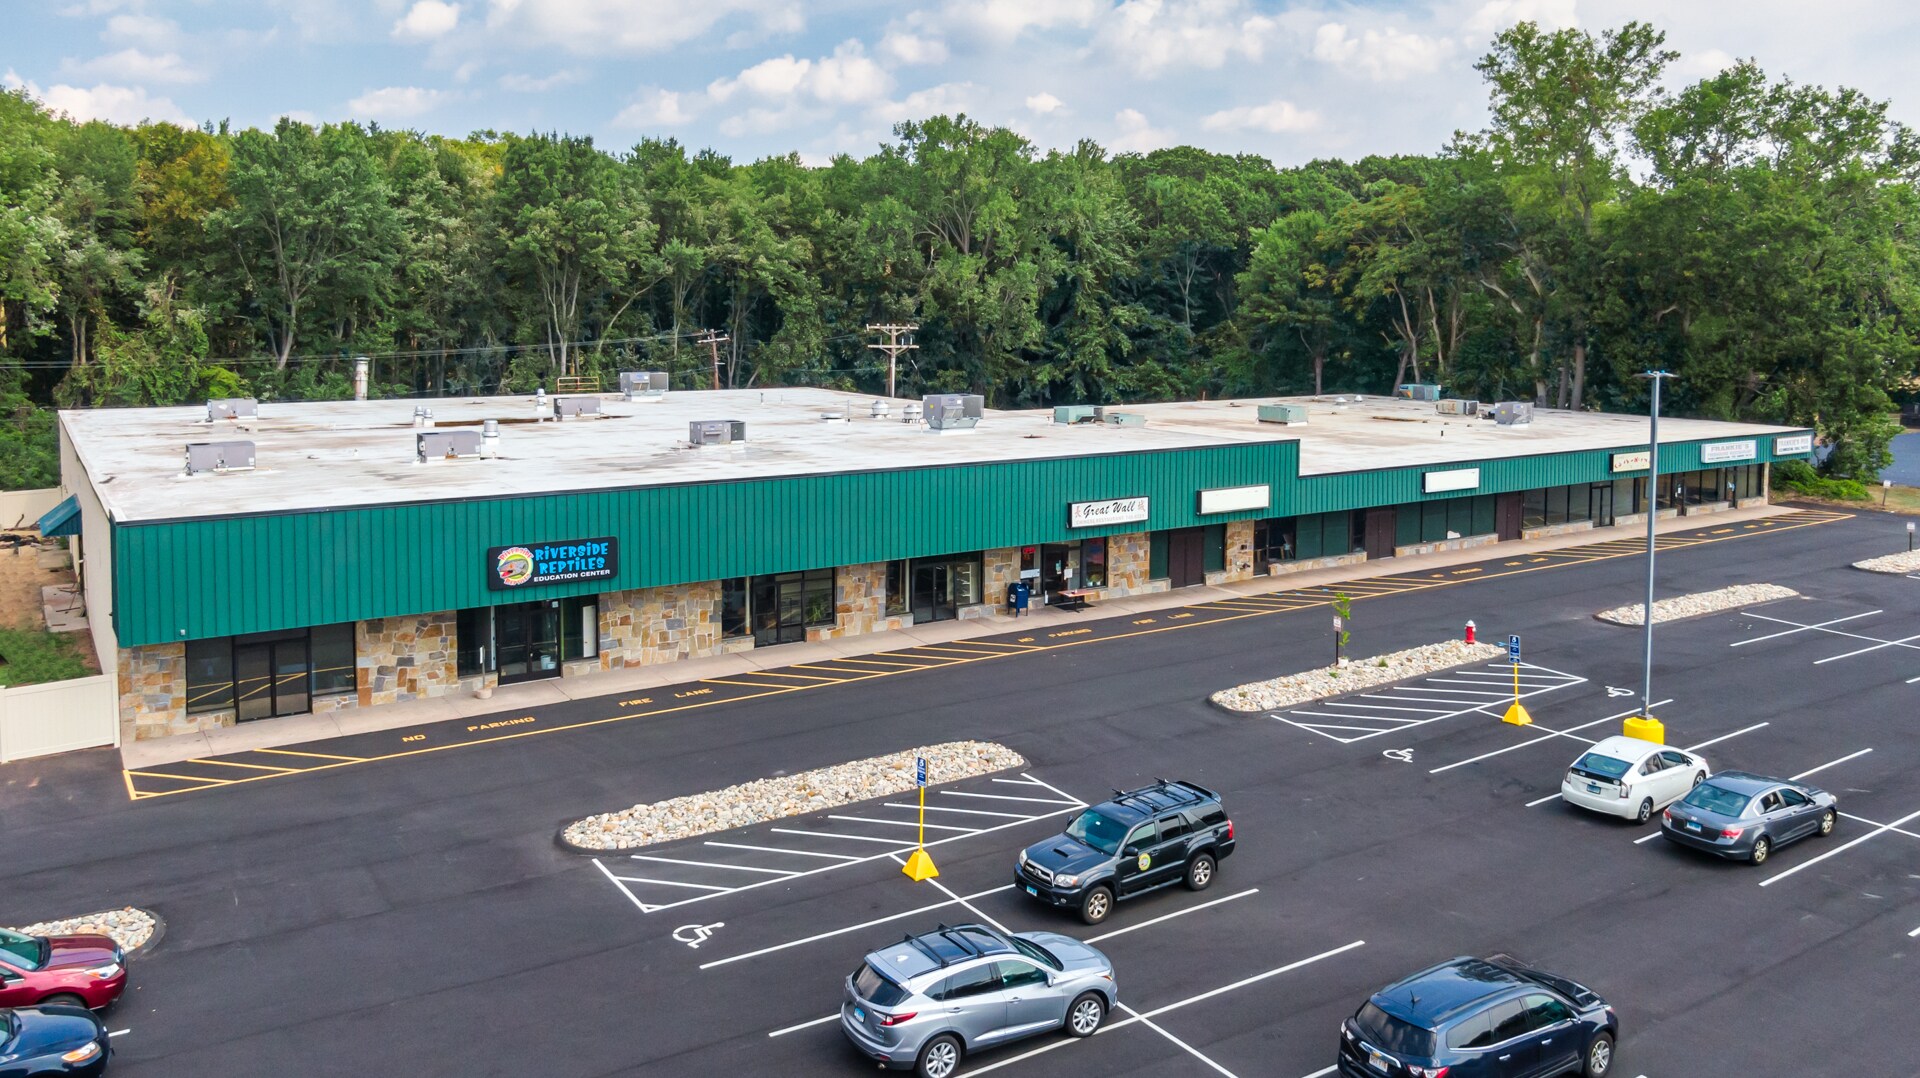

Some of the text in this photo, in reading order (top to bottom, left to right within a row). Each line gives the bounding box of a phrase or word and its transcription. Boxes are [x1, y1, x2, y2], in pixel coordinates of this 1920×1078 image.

[1083, 504, 1109, 519] Great
[1112, 500, 1136, 513] Wall
[533, 569, 611, 583] EDUCATION CENTER
[401, 687, 714, 743] NO PARKING FIRE LANE
